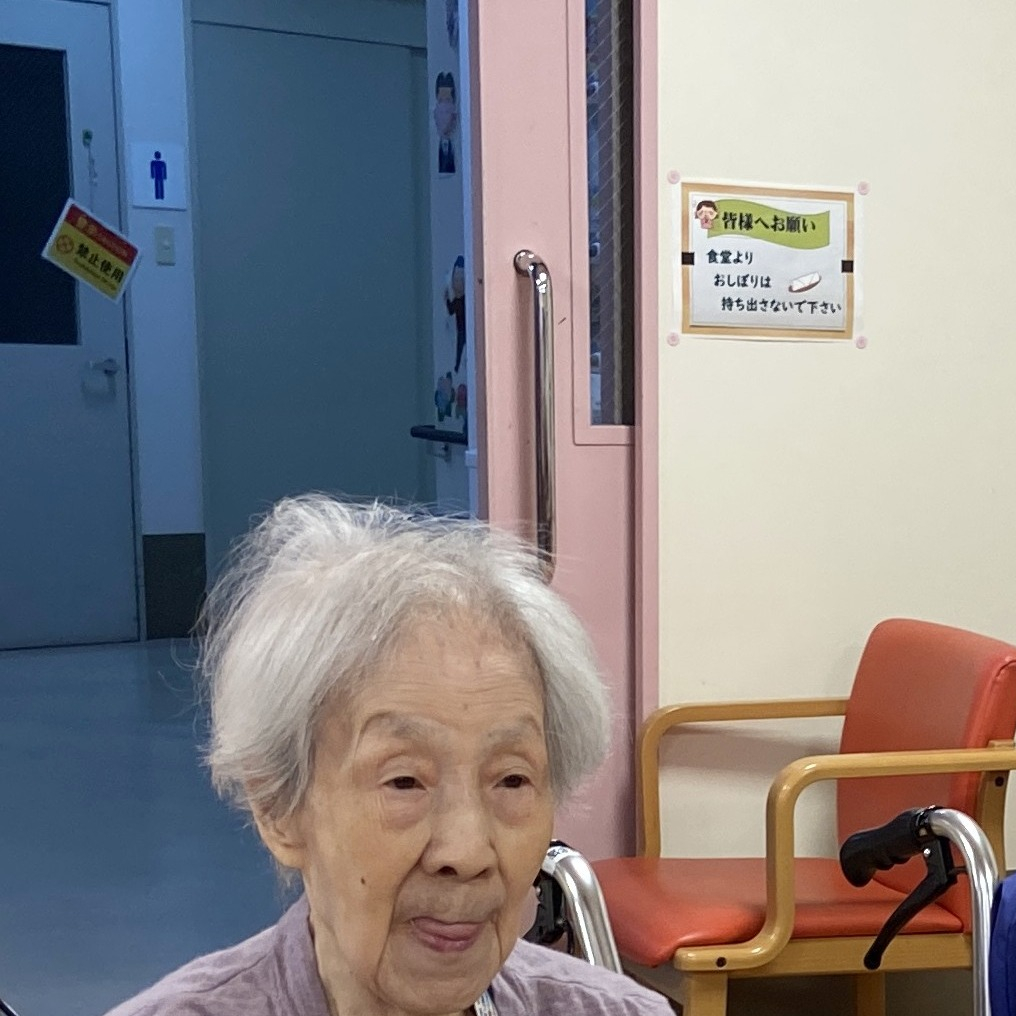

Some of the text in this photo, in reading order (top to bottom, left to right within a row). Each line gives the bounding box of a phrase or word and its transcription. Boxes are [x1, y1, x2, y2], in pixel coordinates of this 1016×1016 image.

[722, 211, 816, 234] 皆様へお願い
[706, 249, 753, 265] 食堂より
[714, 273, 772, 288] おしぼりは
[721, 296, 842, 314] 持ち出さないで下さい
